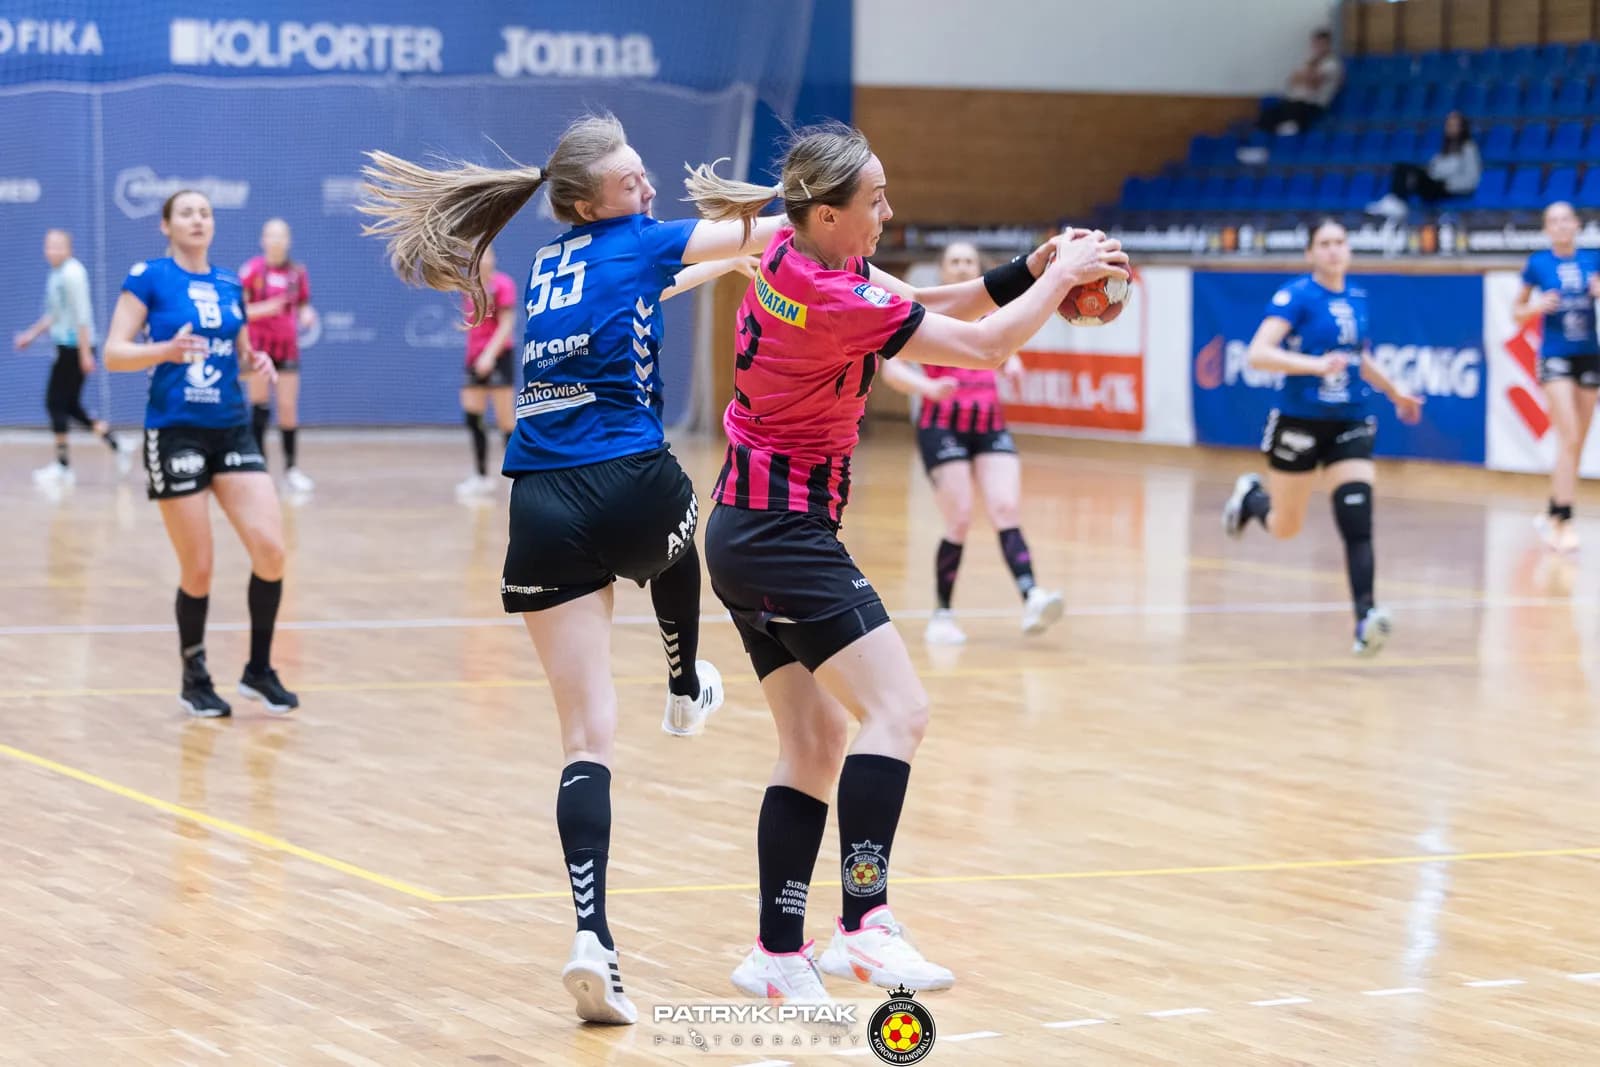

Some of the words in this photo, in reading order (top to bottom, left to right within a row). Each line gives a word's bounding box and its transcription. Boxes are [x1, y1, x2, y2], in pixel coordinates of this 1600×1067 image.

[199, 18, 443, 72] KOLPORTER
[526, 234, 593, 321] 55
[516, 382, 588, 406] ankowiak
